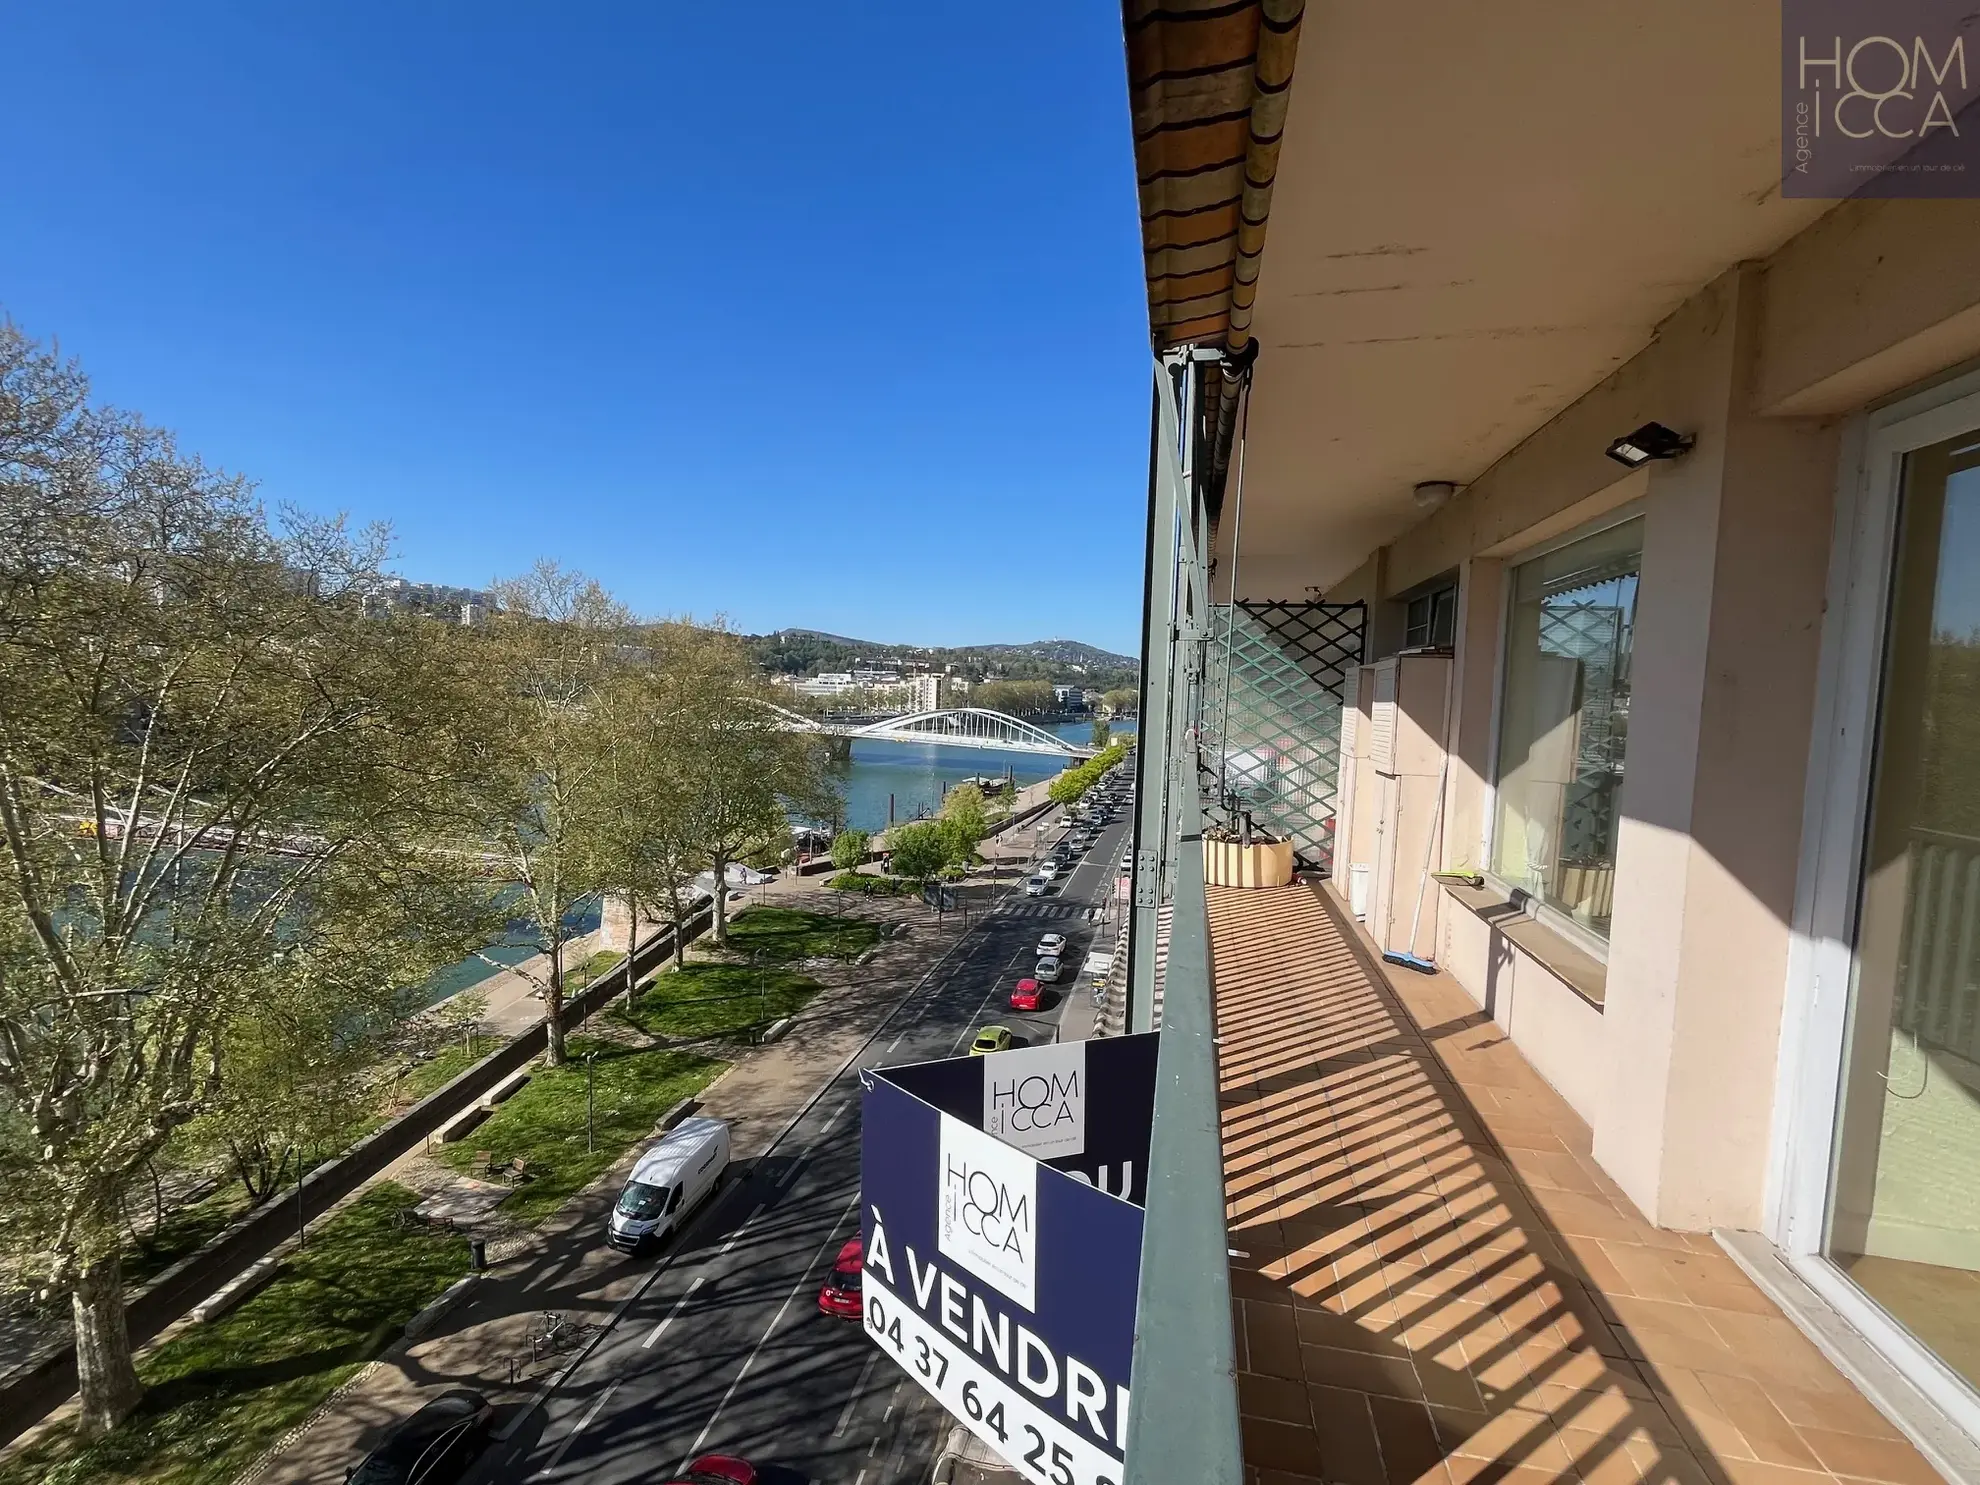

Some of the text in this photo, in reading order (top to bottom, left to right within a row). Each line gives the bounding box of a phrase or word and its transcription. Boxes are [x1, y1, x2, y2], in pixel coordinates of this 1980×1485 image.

[993, 1070, 1078, 1110] HOM
[944, 1194, 953, 1242] Agence
[948, 1153, 1028, 1232] HOM
[866, 1204, 895, 1285] À
[869, 1296, 1075, 1485] 04 37 64 25
